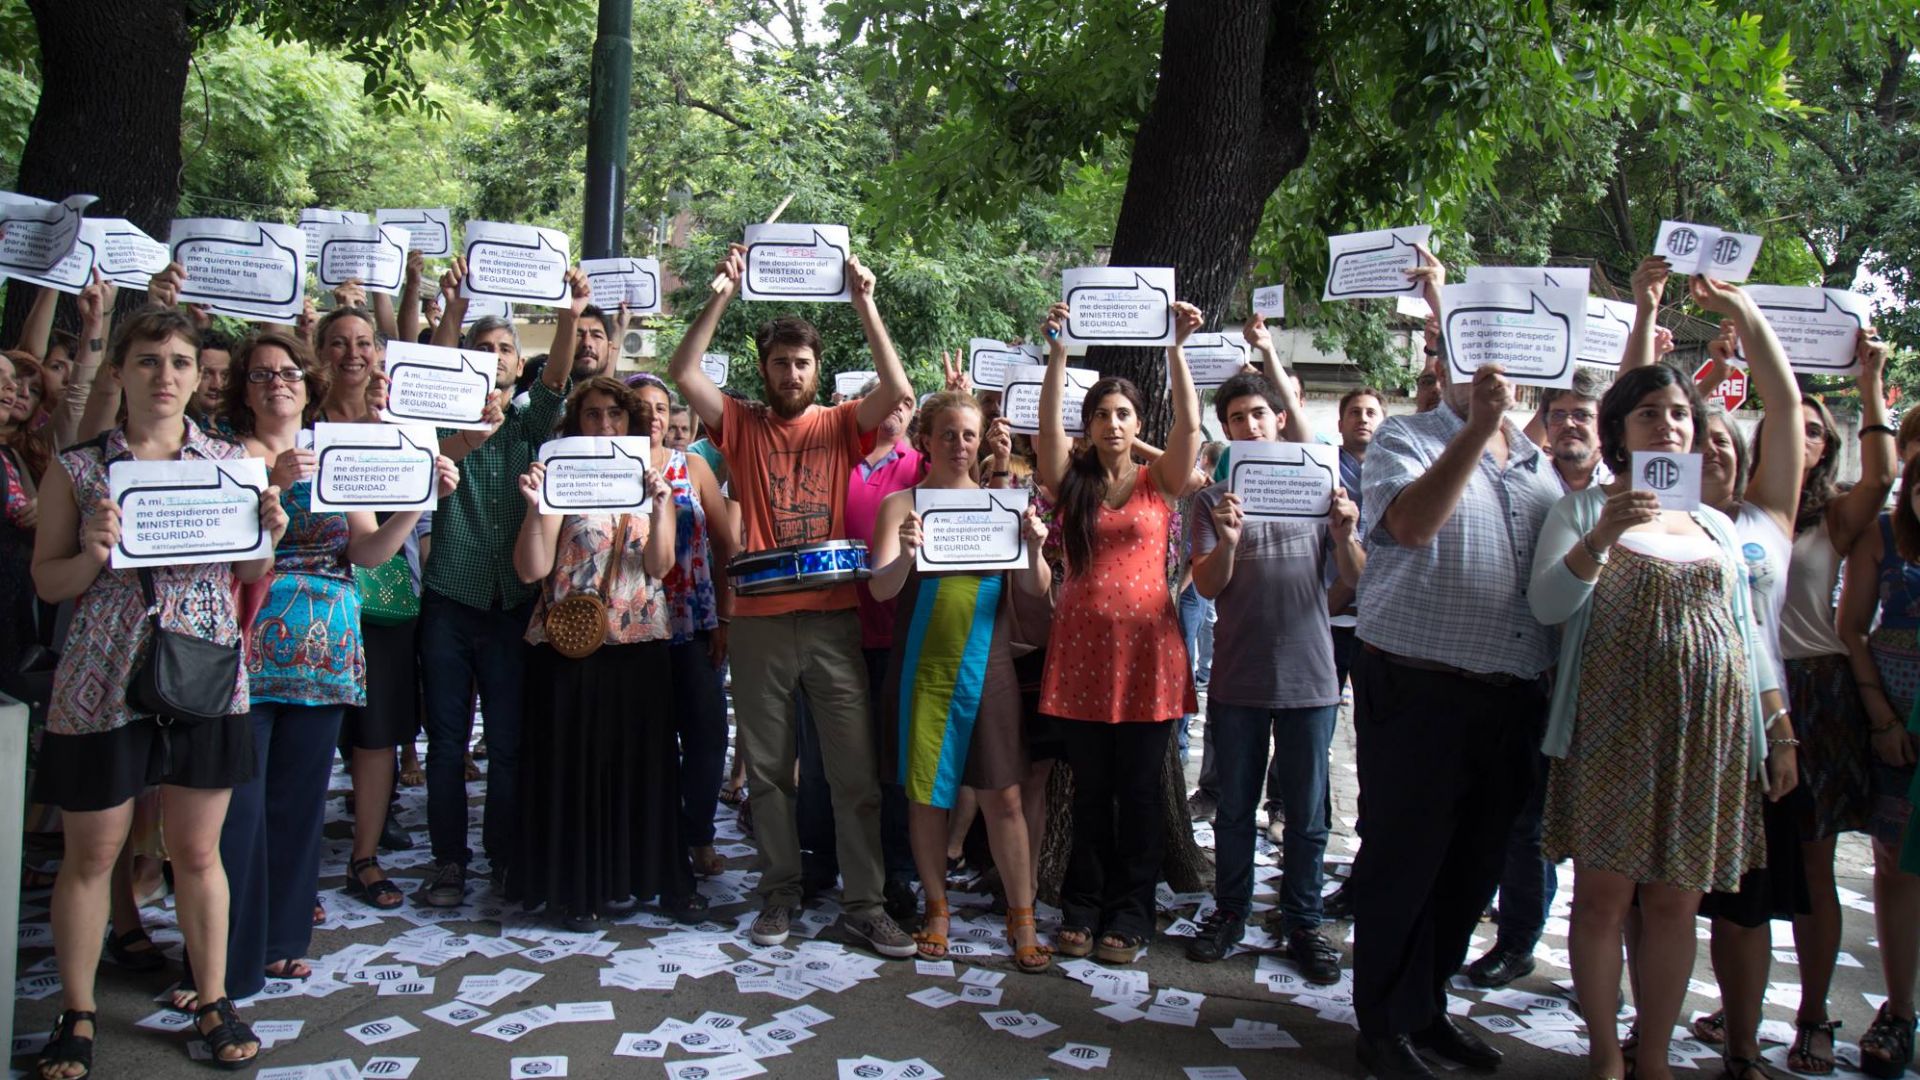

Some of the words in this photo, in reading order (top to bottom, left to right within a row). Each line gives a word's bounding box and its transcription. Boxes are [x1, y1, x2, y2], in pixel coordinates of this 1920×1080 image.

[1667, 227, 1699, 256] ATE
[1711, 236, 1742, 265] ATE
[205, 257, 240, 265] quieren
[242, 260, 283, 270] despedir
[493, 260, 537, 269] despidieron
[187, 265, 208, 273] para
[211, 266, 240, 276] limitar
[243, 270, 257, 278] tus
[480, 266, 525, 276] MINISTERIO
[1477, 330, 1514, 338] quieren
[1515, 332, 1555, 340] despedir
[1462, 342, 1482, 350] para
[1485, 342, 1532, 351] disciplinar
[416, 384, 458, 392] despidieron
[1711, 379, 1743, 397] RE
[401, 390, 446, 400] MINISTERIO
[1644, 457, 1680, 490] ATE
[157, 507, 219, 517] despidieron
[222, 506, 237, 514] del
[137, 519, 202, 528] MINISTERIO
[206, 518, 220, 526] DE
[360, 1023, 392, 1036] ATE
[1070, 1047, 1099, 1059] ATE
[367, 1061, 400, 1074] ATE
